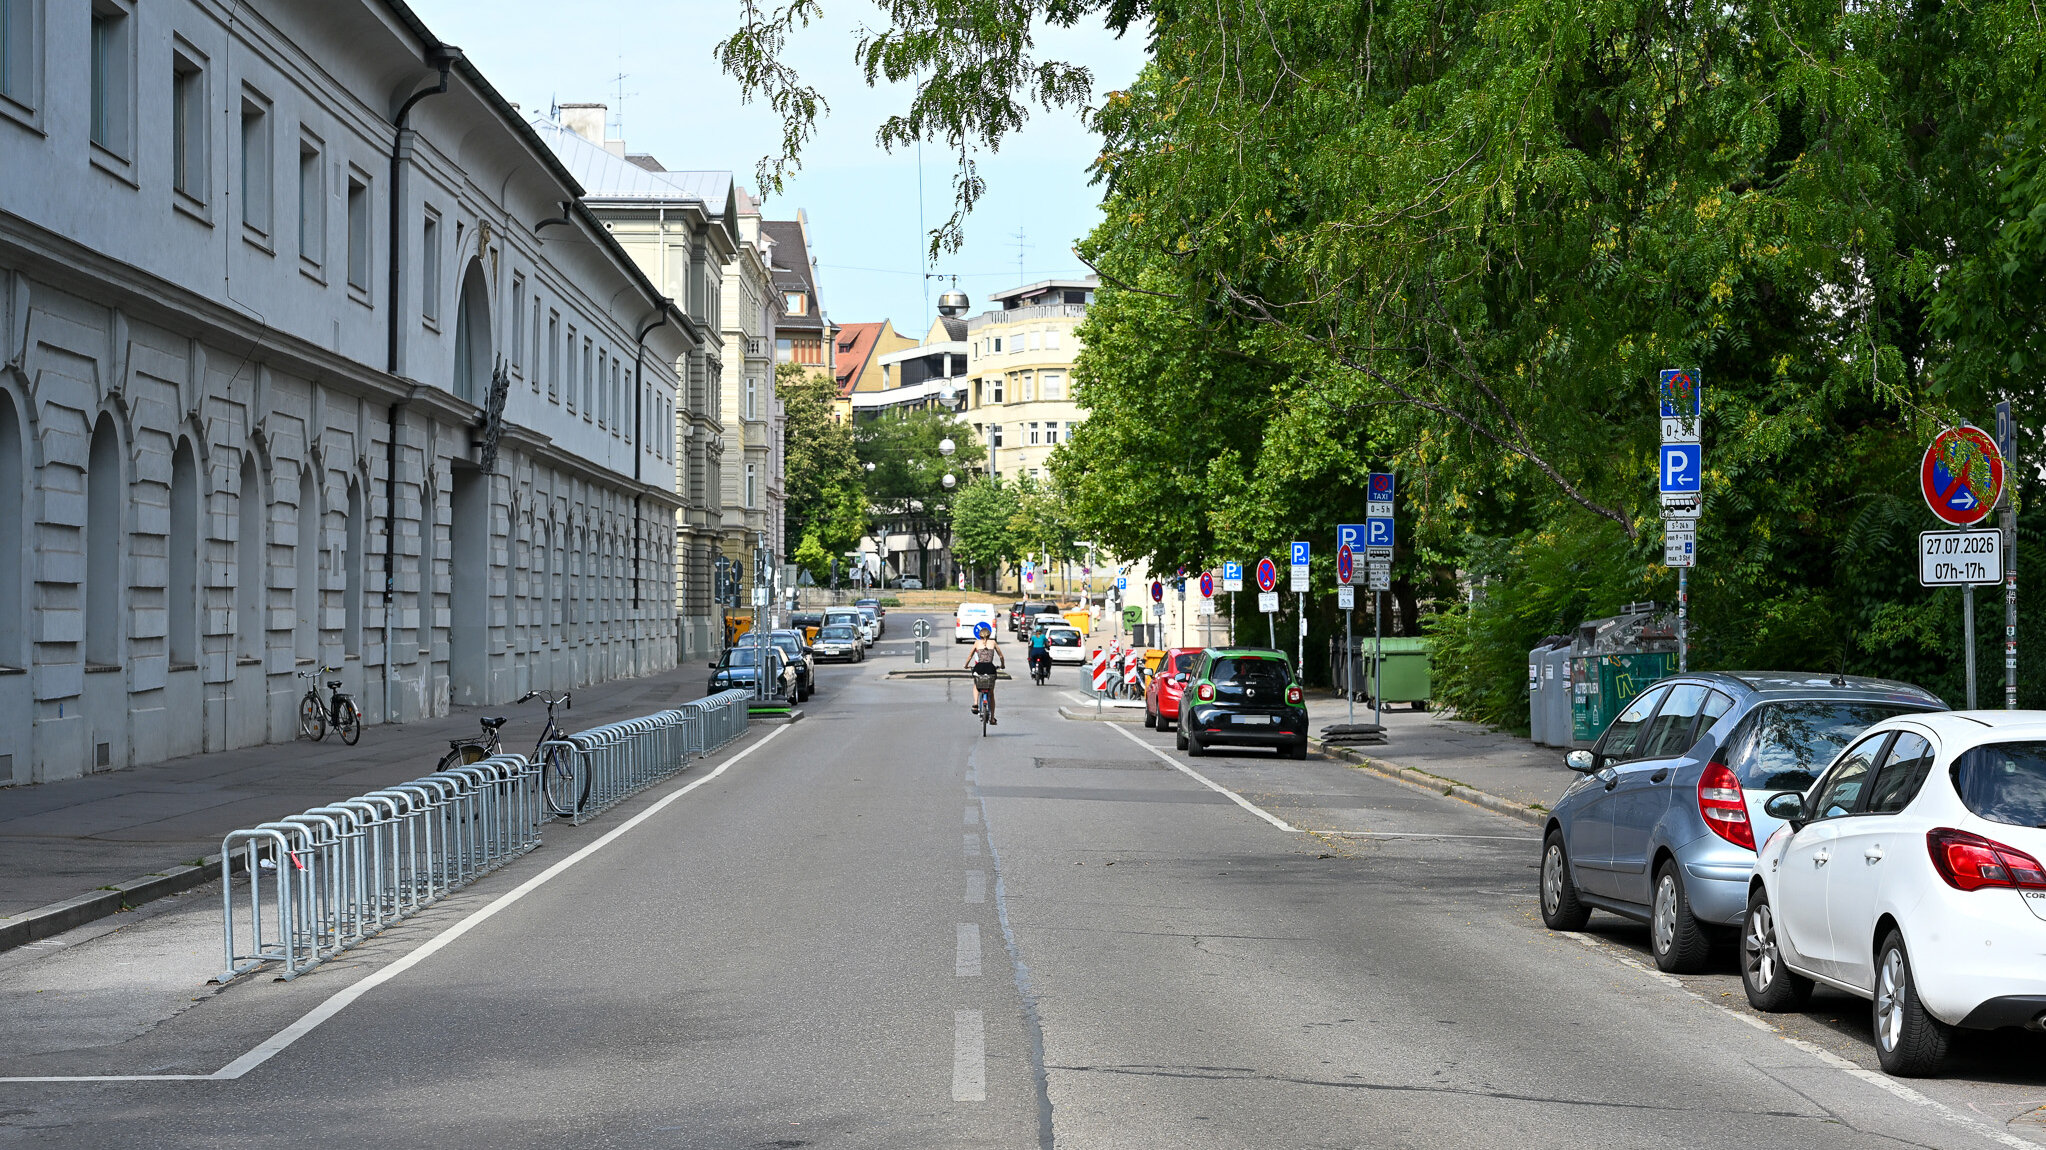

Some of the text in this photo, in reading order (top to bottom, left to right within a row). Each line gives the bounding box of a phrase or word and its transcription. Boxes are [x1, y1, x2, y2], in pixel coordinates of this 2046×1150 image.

[1666, 424, 1672, 436] 0
[1682, 424, 1687, 436] 5
[1667, 450, 1688, 486] P
[1343, 528, 1357, 546] P
[1371, 521, 1385, 542] P
[1294, 545, 1304, 562] P
[1926, 537, 1994, 554] 27.07.2026
[1226, 563, 1236, 578] P
[1936, 562, 1985, 579] 07h-17h
